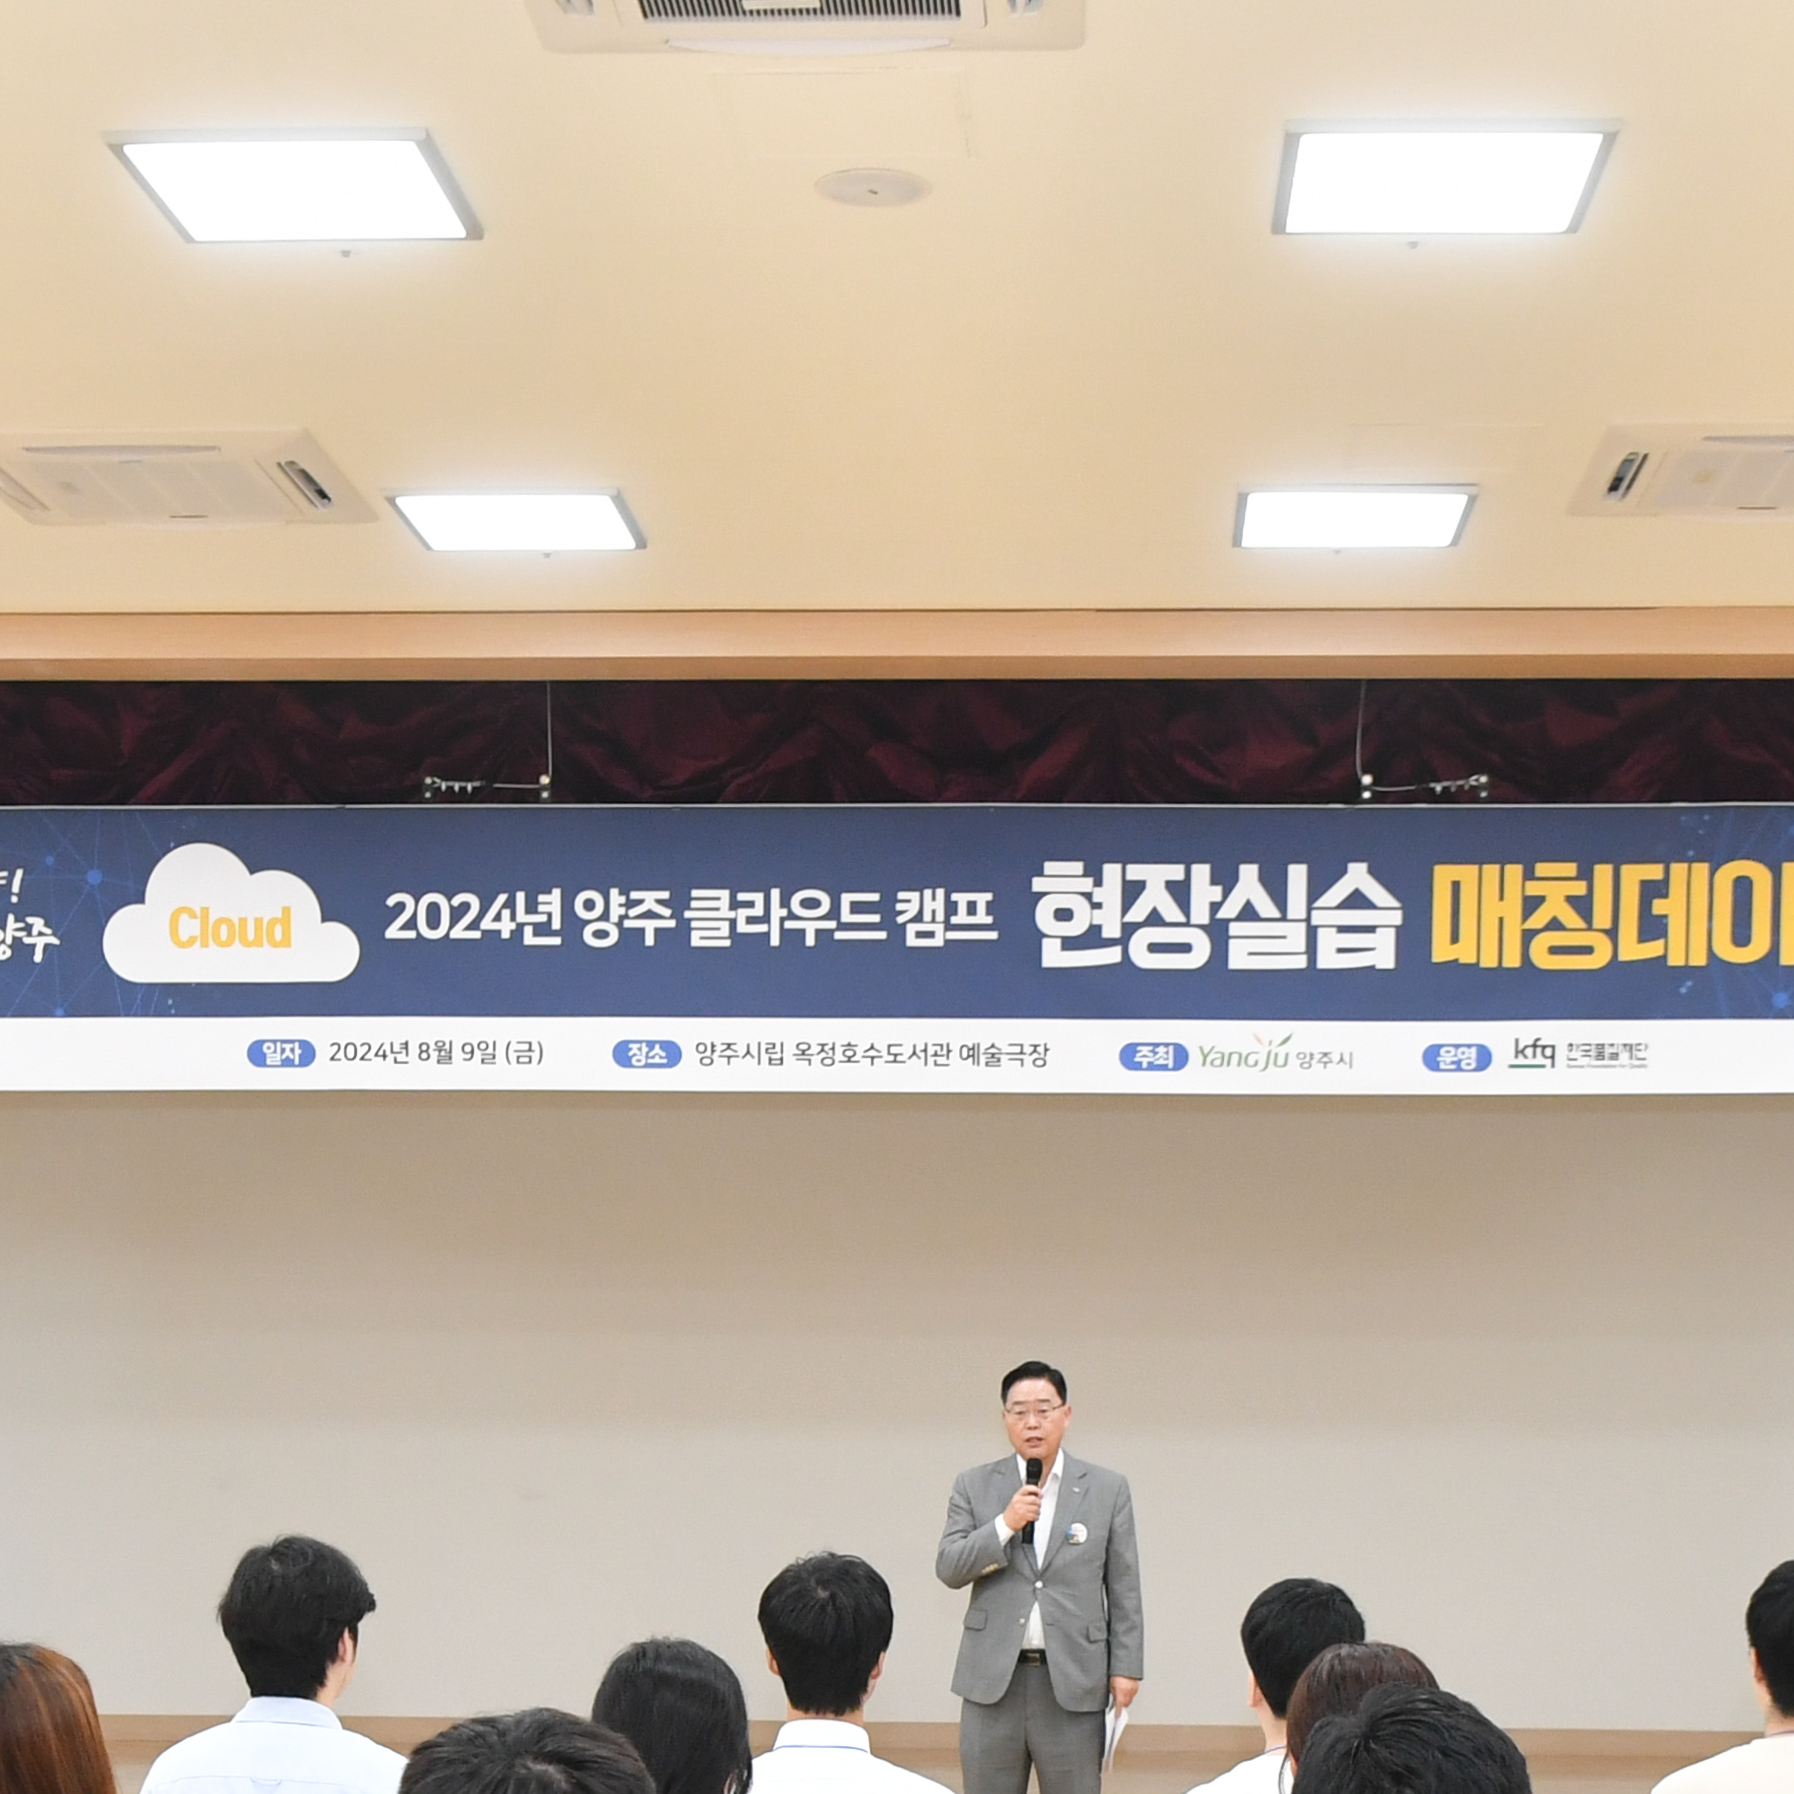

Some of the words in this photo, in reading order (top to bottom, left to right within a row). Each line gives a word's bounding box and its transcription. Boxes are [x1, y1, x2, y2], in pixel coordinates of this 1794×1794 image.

[168, 905, 293, 949] Cloud
[384, 887, 562, 946] 2024년
[573, 887, 677, 948] 양주
[683, 887, 888, 948] 클라우드
[895, 887, 999, 948] 캠프
[1031, 861, 1403, 970] 현장실습
[261, 1040, 302, 1066] 일자
[329, 1040, 409, 1065] 2024년
[417, 1040, 453, 1065] 8월
[461, 1040, 497, 1065] 9일
[505, 1040, 544, 1065] (금)
[627, 1041, 669, 1066] 장소
[695, 1041, 785, 1067] 양주시립
[792, 1041, 953, 1067] 옥정호수도서관
[959, 1042, 1051, 1068] 예술극장
[1132, 1045, 1176, 1070] 주최
[1296, 1051, 1353, 1070] 양주시
[1436, 1045, 1478, 1070] 운영
[1511, 1037, 1556, 1069] kfq
